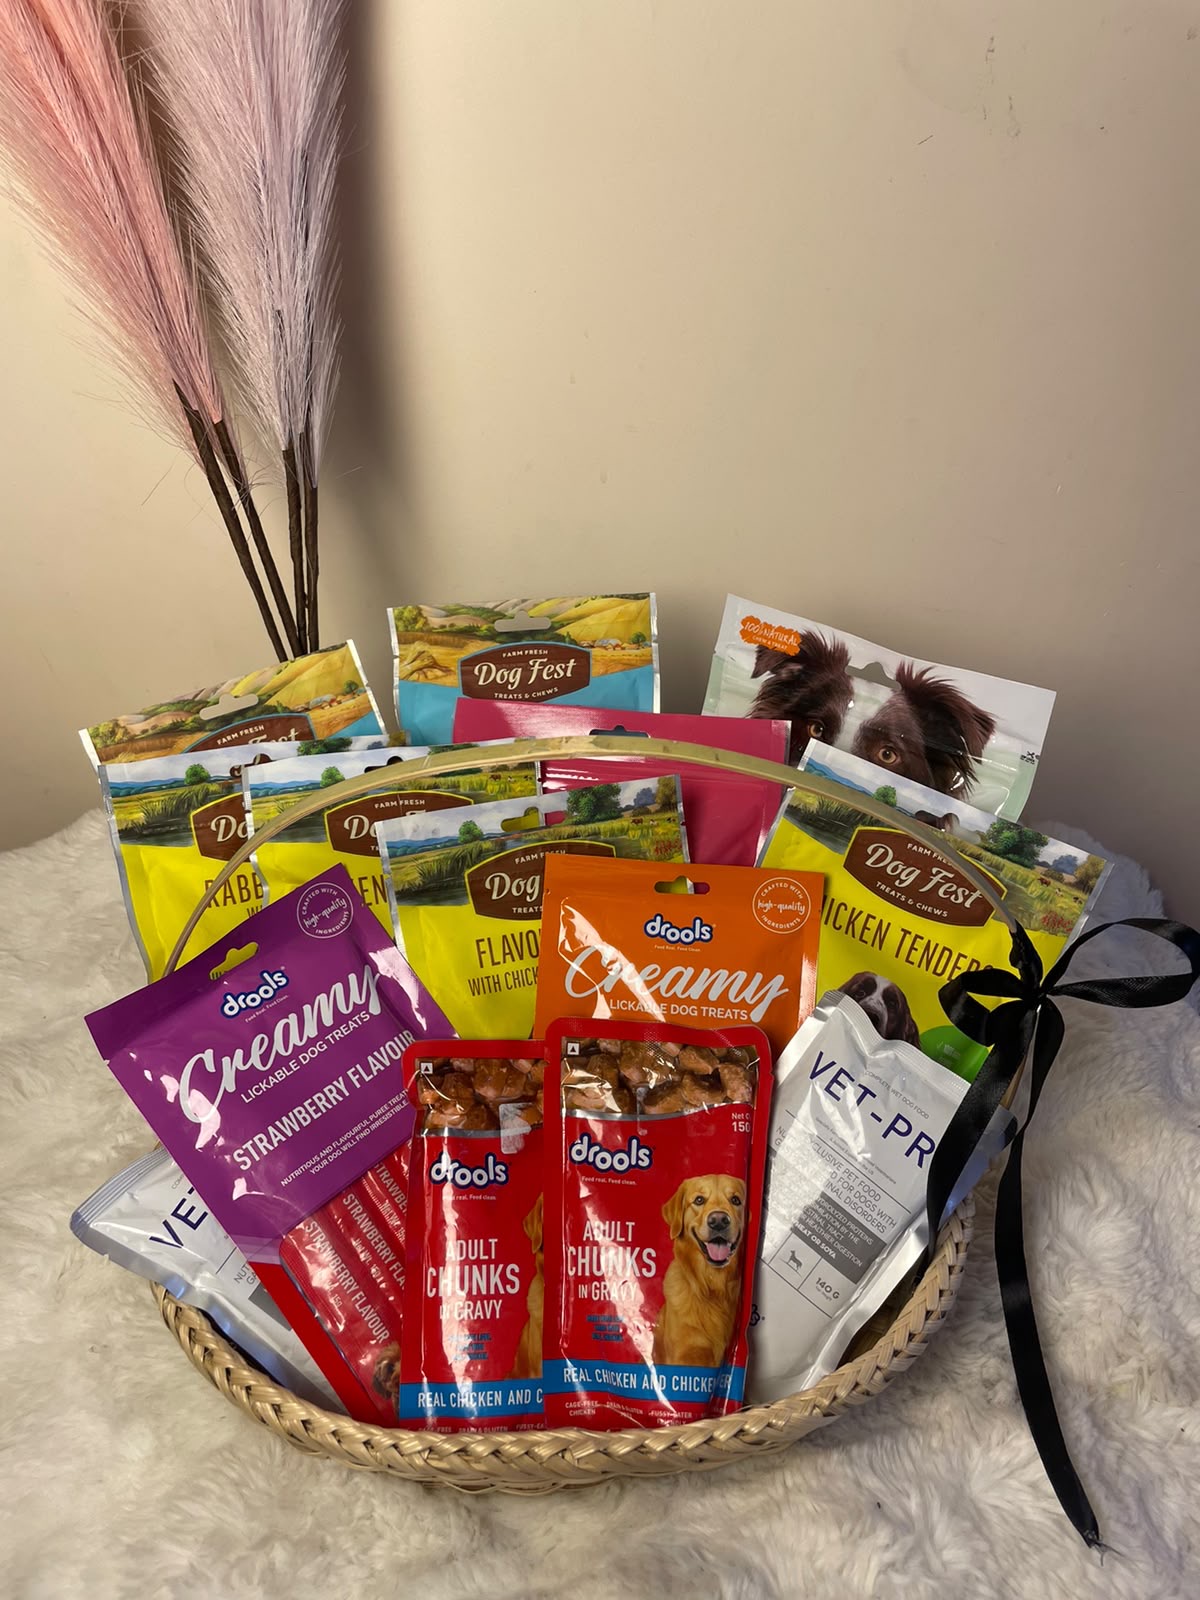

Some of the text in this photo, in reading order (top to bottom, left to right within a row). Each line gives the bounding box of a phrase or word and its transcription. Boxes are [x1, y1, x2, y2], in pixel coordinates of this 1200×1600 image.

[502, 650, 524, 658] FARM
[474, 658, 577, 690] Dog Fest
[531, 686, 558, 698] CHEWS
[217, 732, 239, 745] FARM
[240, 724, 265, 736] FRESH
[374, 800, 398, 808] FARM
[514, 854, 538, 864] FARM
[907, 843, 931, 857] FARM
[484, 872, 540, 902] Dog
[864, 843, 982, 908] Dog Fest
[302, 888, 320, 916] CRAFTED
[320, 888, 338, 896] WITH
[760, 882, 804, 900] CRAFTED WITH
[876, 881, 906, 902] TREATS
[916, 902, 948, 918] CHEWS
[303, 898, 348, 928] high-quality
[757, 898, 806, 916] high-quality
[761, 914, 801, 929] INGREDIENTS
[315, 911, 350, 934] INGREDIENTS
[646, 914, 712, 944] drools
[821, 896, 892, 951] ICKEN
[222, 970, 288, 1017] drools
[468, 975, 502, 997] WITH
[564, 944, 789, 1023] Creamy
[609, 998, 748, 1020] LICKABLE DOG TREATS
[179, 964, 382, 1123] Creamy
[240, 1010, 370, 1104] LICKABLE DOG TREATS
[232, 1029, 416, 1171] STRAWBERRY FLAVOUR
[890, 1088, 903, 1099] WET
[901, 1096, 915, 1108] DOG
[913, 1105, 930, 1120] FOOD
[731, 1112, 745, 1120] Net
[279, 1155, 321, 1186] NUTRITIOUS
[318, 1144, 334, 1158] AND
[331, 1118, 371, 1148] FLAVOURFUL
[368, 1105, 389, 1122] PUREE
[309, 1158, 329, 1175] YOUR
[327, 1148, 343, 1162] DOG
[340, 1138, 358, 1152] WILL
[355, 1127, 372, 1141] FIND
[570, 1134, 652, 1172] drools
[430, 1152, 508, 1188] drools
[811, 1140, 844, 1170] CLUSIVE
[842, 1168, 859, 1184] PET
[856, 1180, 882, 1202] FOOD
[149, 1187, 208, 1248] VE
[836, 1177, 855, 1194] FOR
[852, 1190, 878, 1213] DOGS
[875, 1209, 898, 1228] WITH
[842, 1196, 888, 1234] DISORDERS
[343, 1193, 397, 1264] STRAWBERRY
[582, 1221, 636, 1242] ADULT
[813, 1195, 874, 1245] YDROLYZED PROTEINS
[825, 1224, 844, 1241] TRACT
[839, 1226, 849, 1235] BY
[846, 1232, 860, 1244] THE
[444, 1238, 498, 1262] ADULT
[804, 1218, 864, 1267] HEALTHIER DIGESTION
[810, 1234, 822, 1246] OR
[819, 1242, 838, 1259] SOYA
[567, 1246, 657, 1278] CHUNKS
[306, 1220, 358, 1294] STRAWBERRY
[352, 1292, 390, 1344] FLAVOUR
[426, 1263, 520, 1298] CHUNKS
[578, 1282, 638, 1302] IN GRAVY
[814, 1277, 835, 1295] 140
[831, 1290, 841, 1300] G
[454, 1299, 502, 1320] GRAVY
[563, 1367, 592, 1383] REAL
[594, 1368, 638, 1389] CHICKEN
[642, 1374, 666, 1390] AND
[418, 1392, 446, 1408] REAL
[450, 1390, 502, 1408] CHICKEN
[507, 1388, 532, 1406] AND
[569, 1408, 596, 1417] CHICKEN
[651, 1410, 692, 1419] FUSSY-ATER
